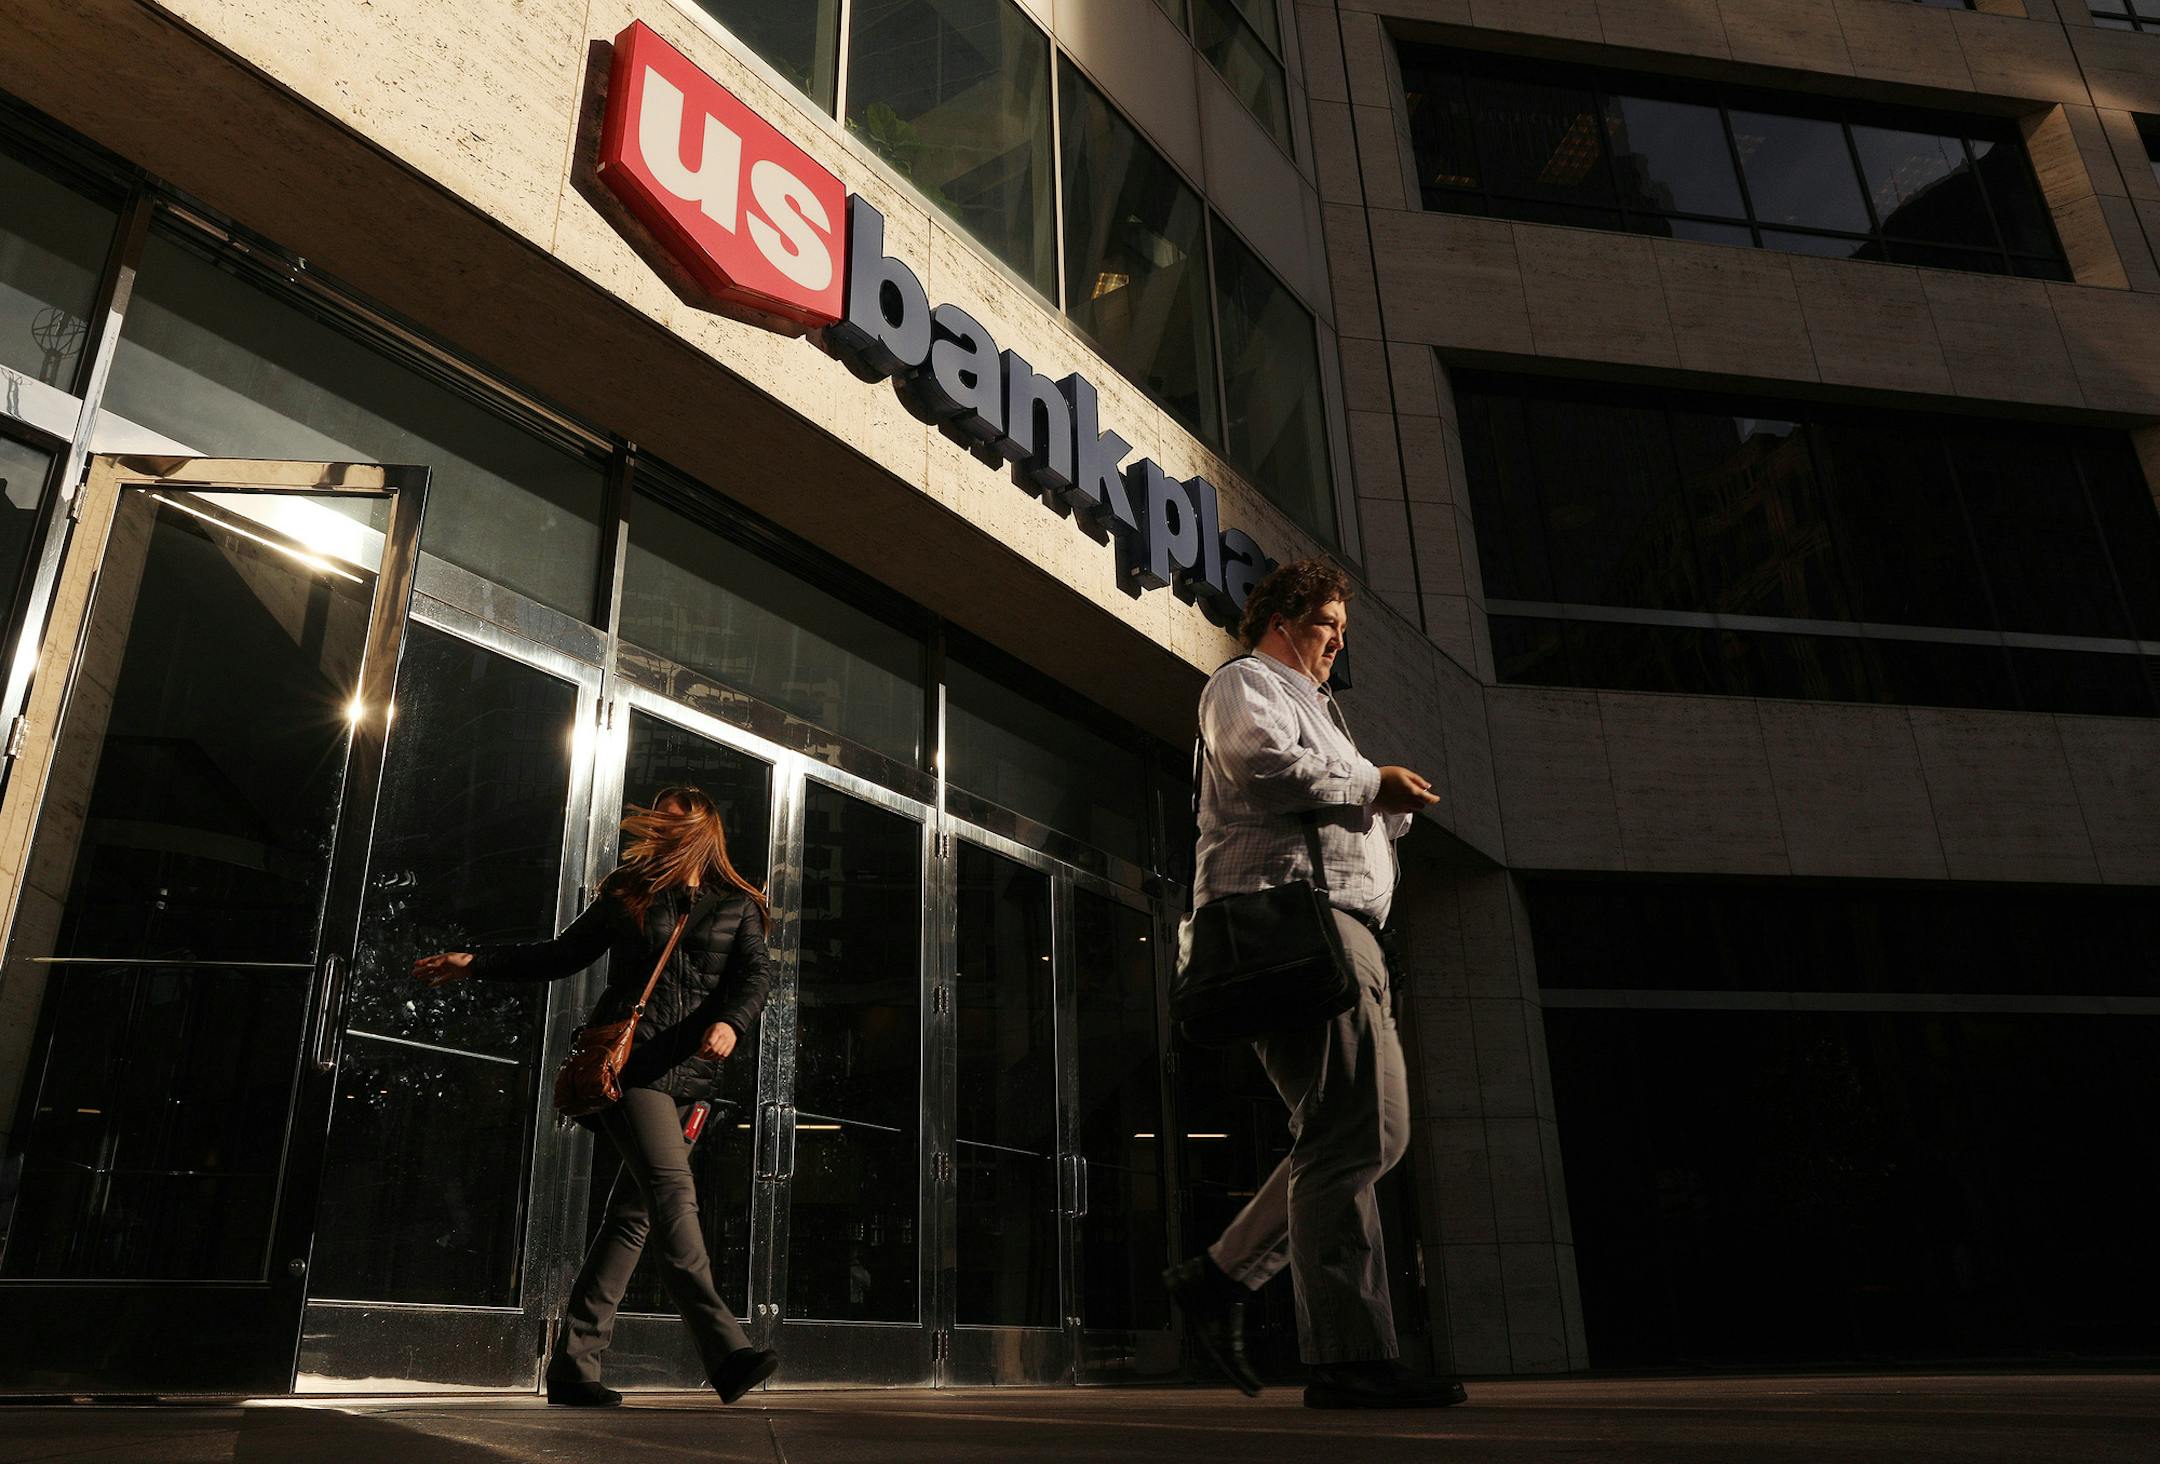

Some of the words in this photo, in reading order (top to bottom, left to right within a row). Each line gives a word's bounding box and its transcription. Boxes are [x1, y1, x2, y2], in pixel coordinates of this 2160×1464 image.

[638, 64, 833, 291] us
[847, 193, 1139, 531] bank
[1145, 458, 1281, 612] pla
